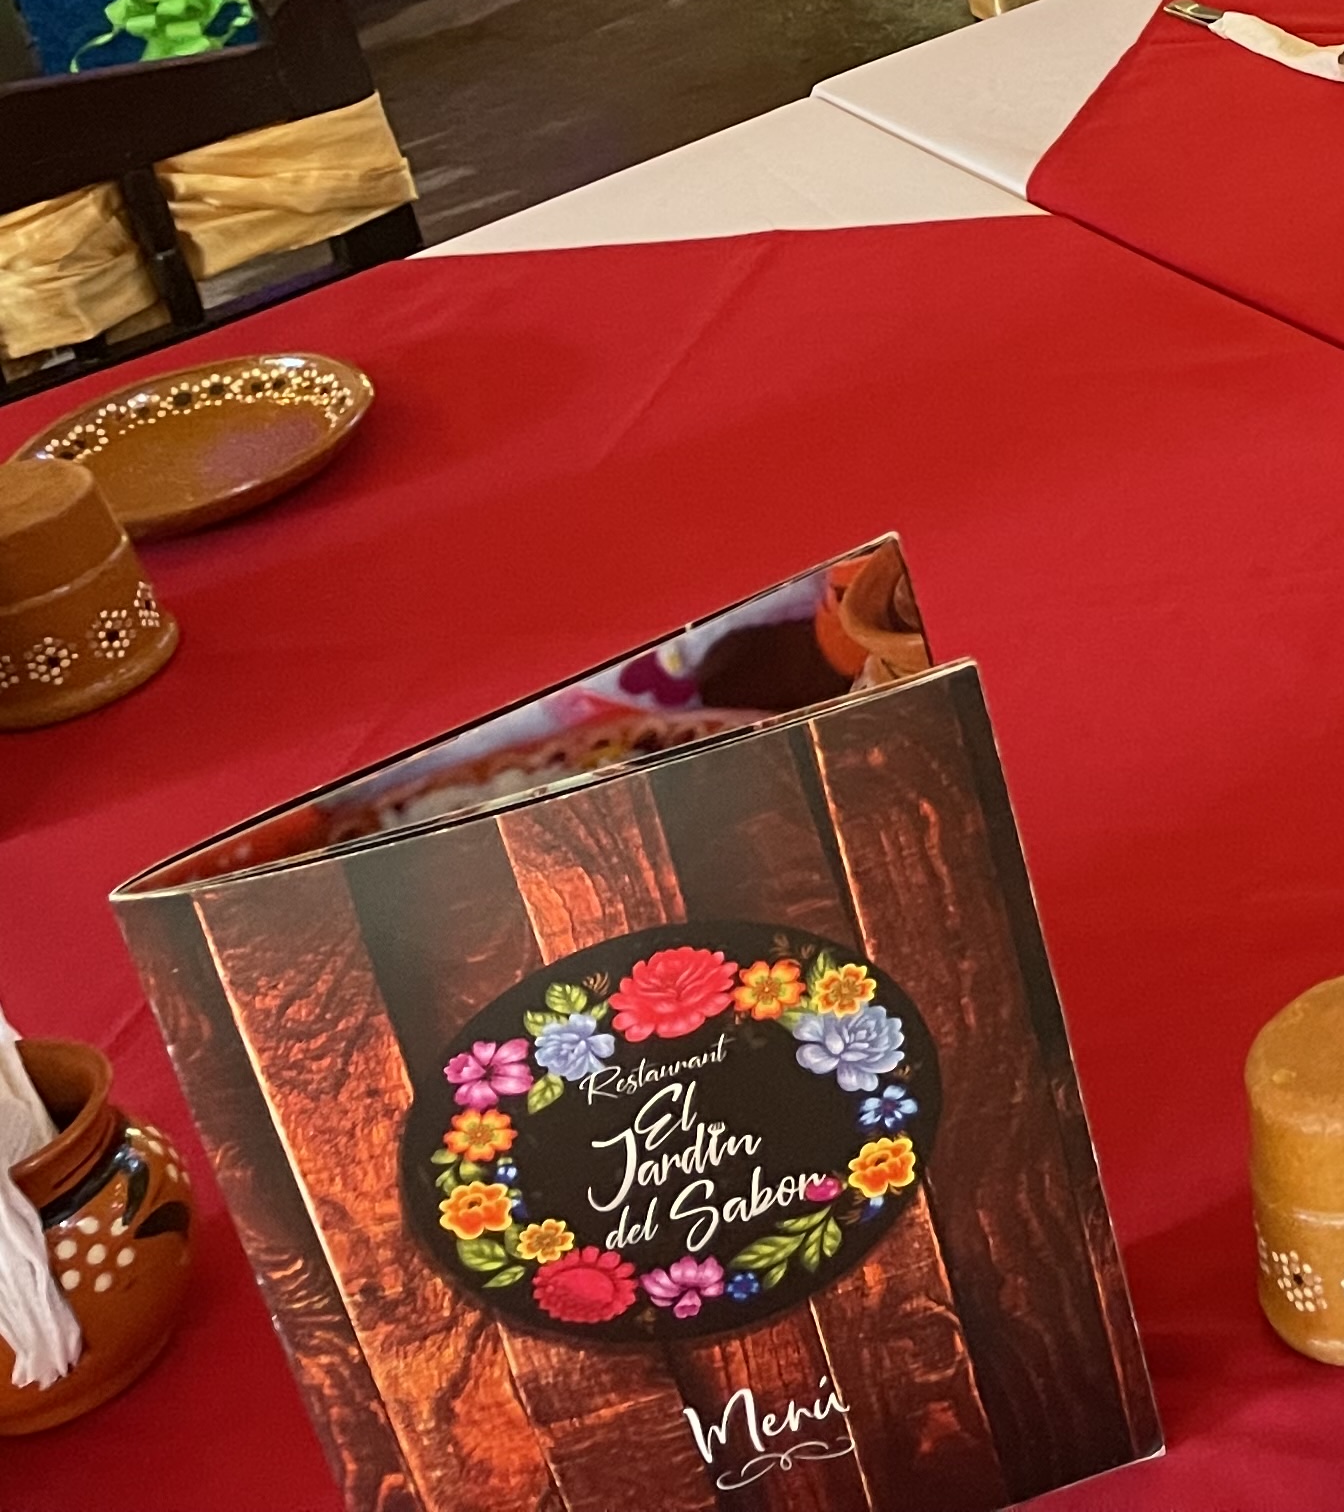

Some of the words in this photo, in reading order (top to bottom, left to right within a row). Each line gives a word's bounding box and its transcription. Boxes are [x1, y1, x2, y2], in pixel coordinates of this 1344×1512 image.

[578, 1033, 736, 1105] Restaurant
[634, 1080, 698, 1151] El
[605, 1196, 659, 1250] del
[684, 1377, 851, 1465] Menú
